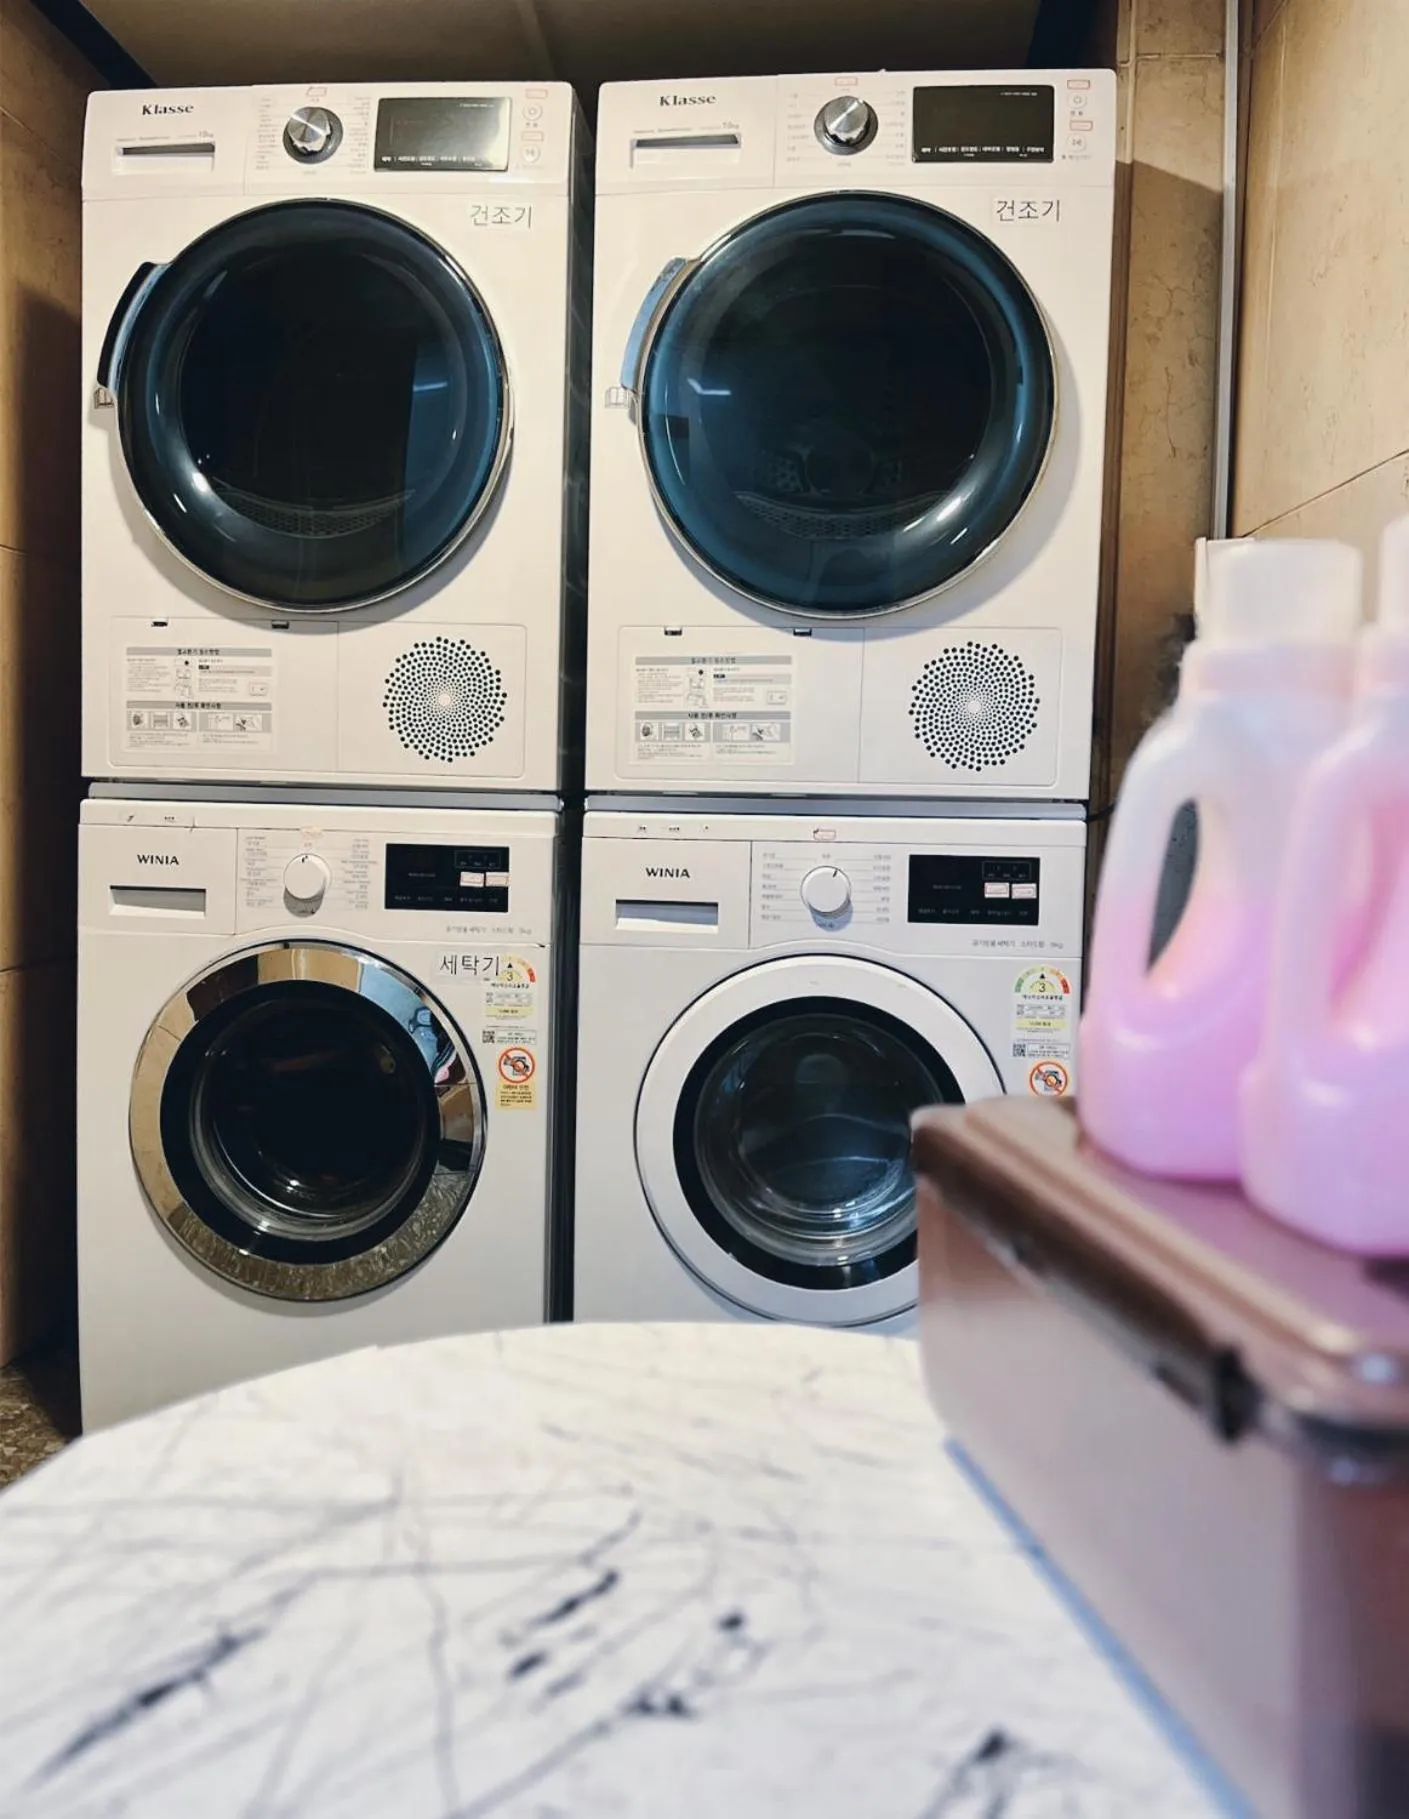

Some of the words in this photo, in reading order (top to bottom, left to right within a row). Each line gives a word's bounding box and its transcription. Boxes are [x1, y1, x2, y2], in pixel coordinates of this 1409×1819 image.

[658, 93, 717, 107] Klasse
[141, 102, 195, 117] Klasse
[470, 204, 533, 229] 건조기
[996, 199, 1061, 223] 건조기
[136, 854, 180, 866] WINIA
[645, 867, 690, 879] WINIA
[439, 954, 500, 977] 세탁기
[506, 971, 514, 982] 3
[1038, 982, 1046, 993] 3
